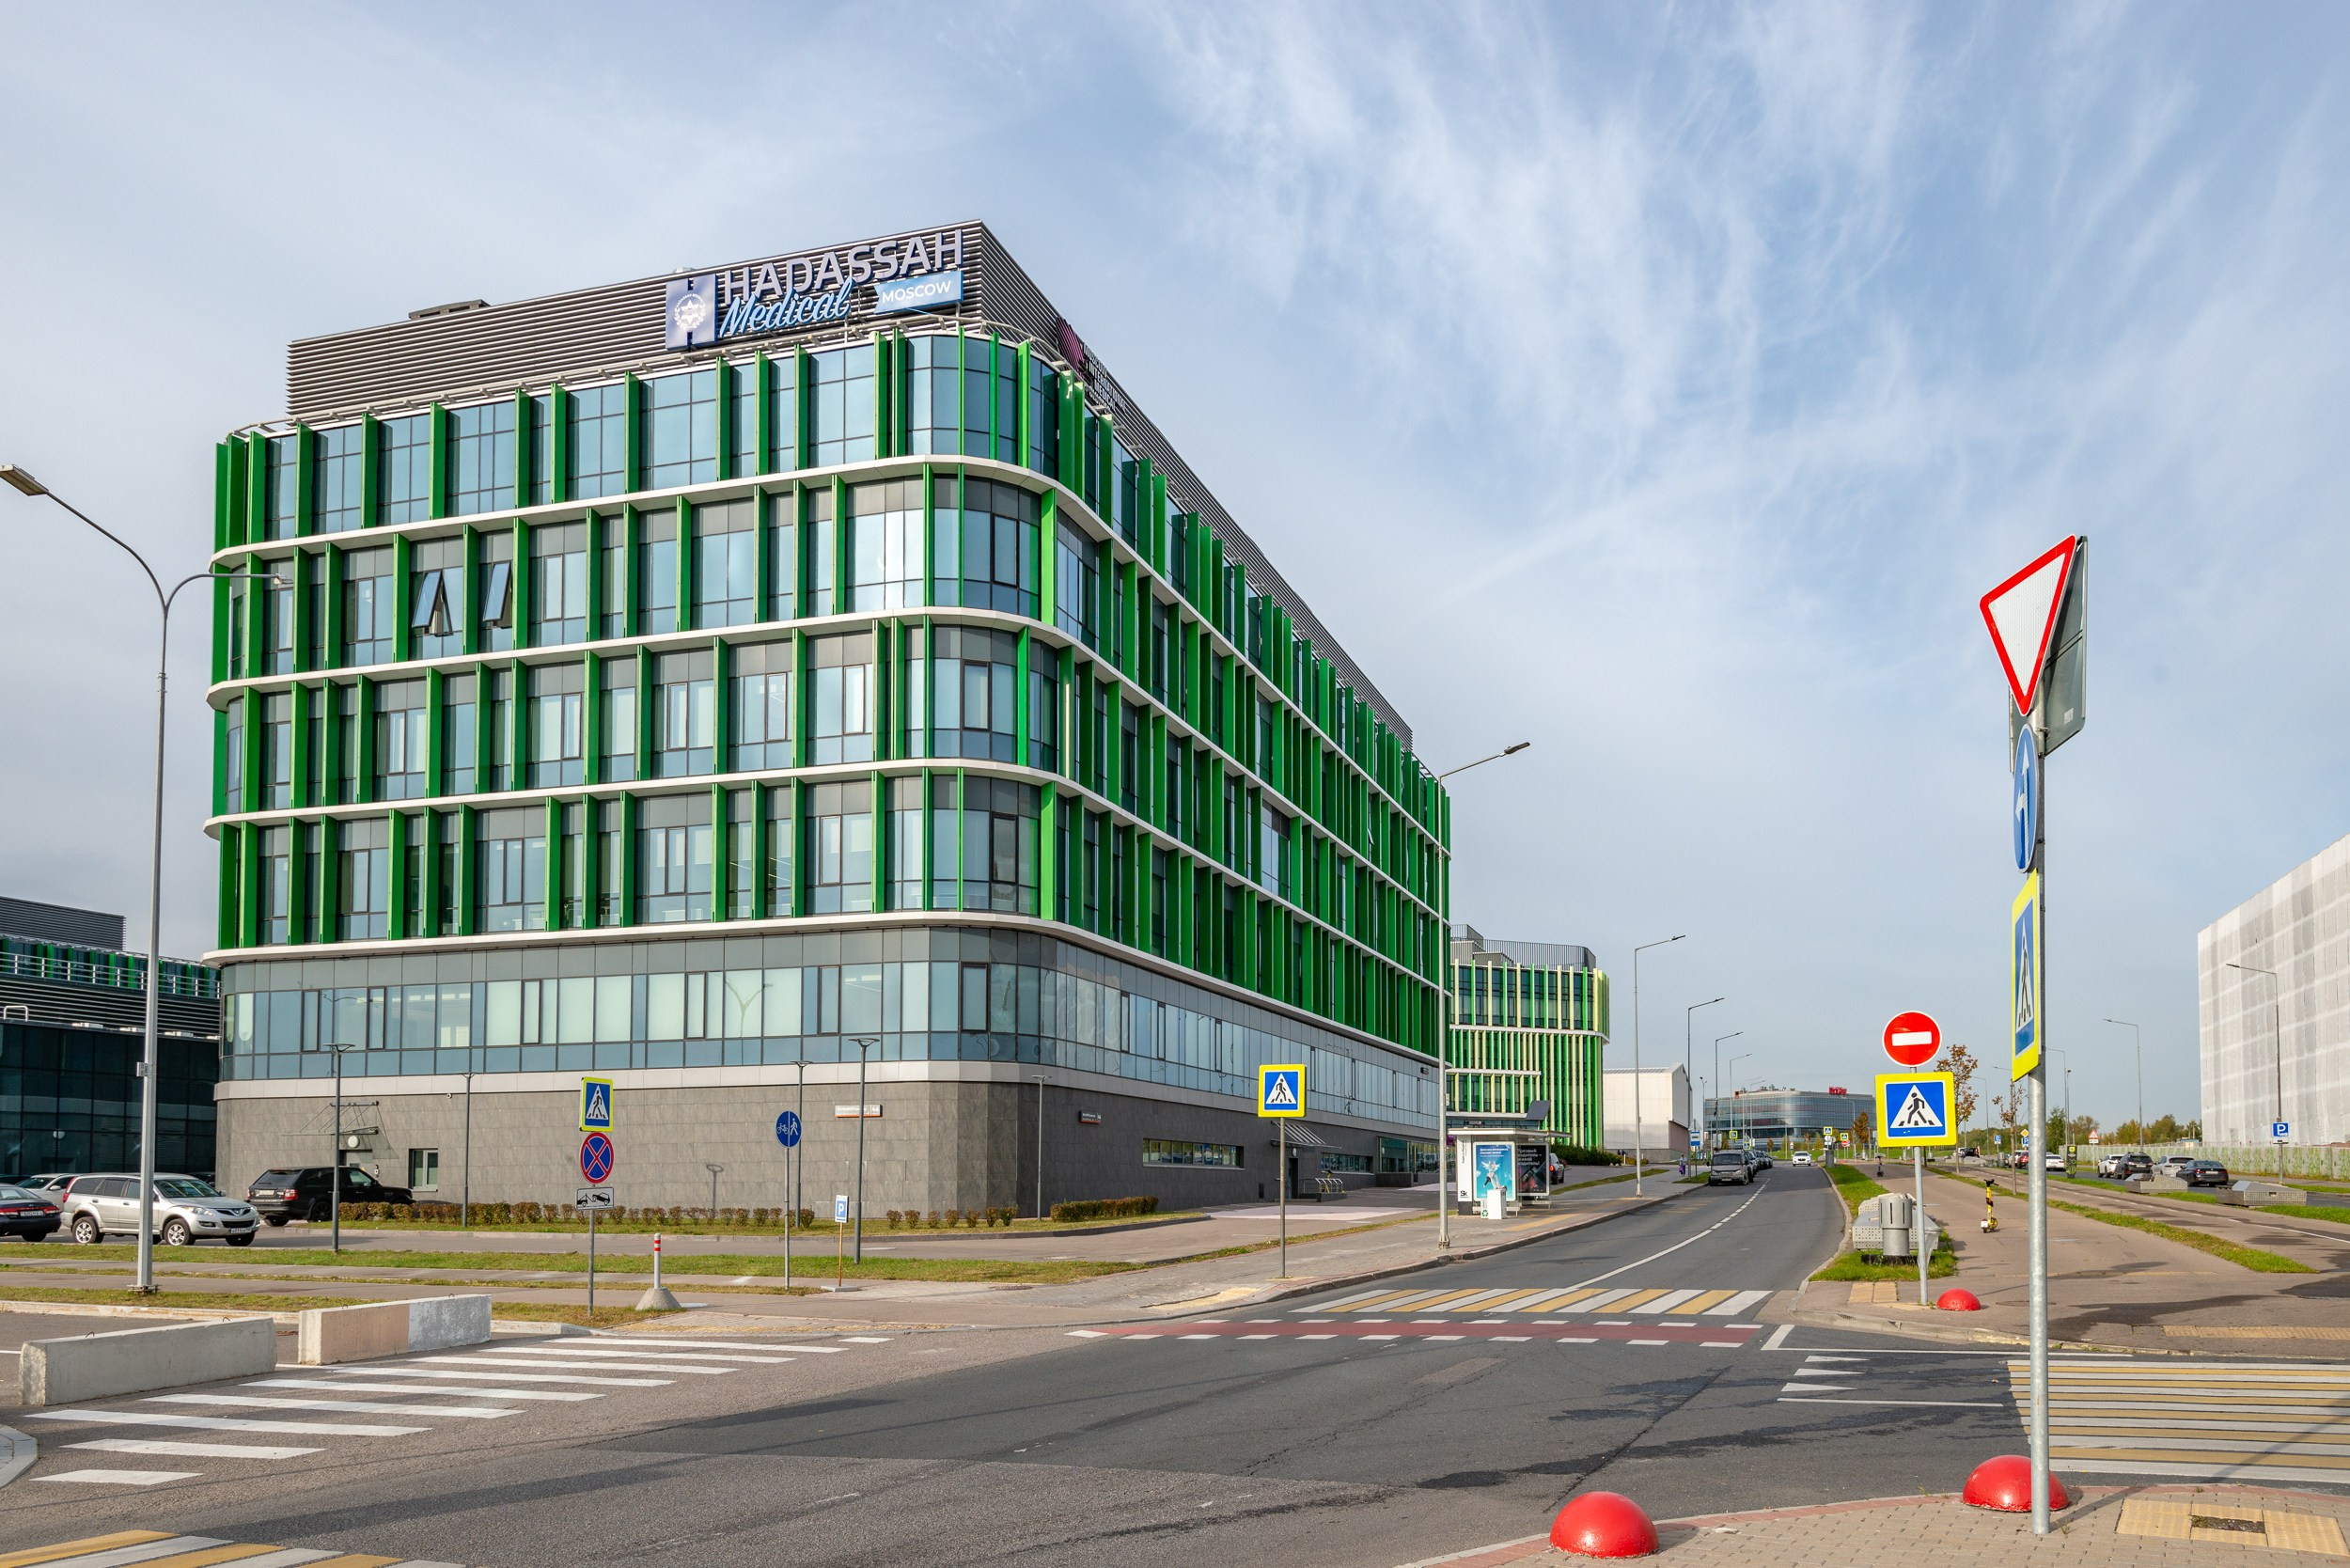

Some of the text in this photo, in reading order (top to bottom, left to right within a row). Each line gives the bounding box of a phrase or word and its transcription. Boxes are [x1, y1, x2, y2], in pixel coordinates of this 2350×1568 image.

[724, 228, 963, 306] HADASSAH
[882, 280, 951, 303] MOSCOW
[719, 274, 854, 337] Medical
[2277, 1124, 2286, 1136] P
[838, 1203, 844, 1215] P
